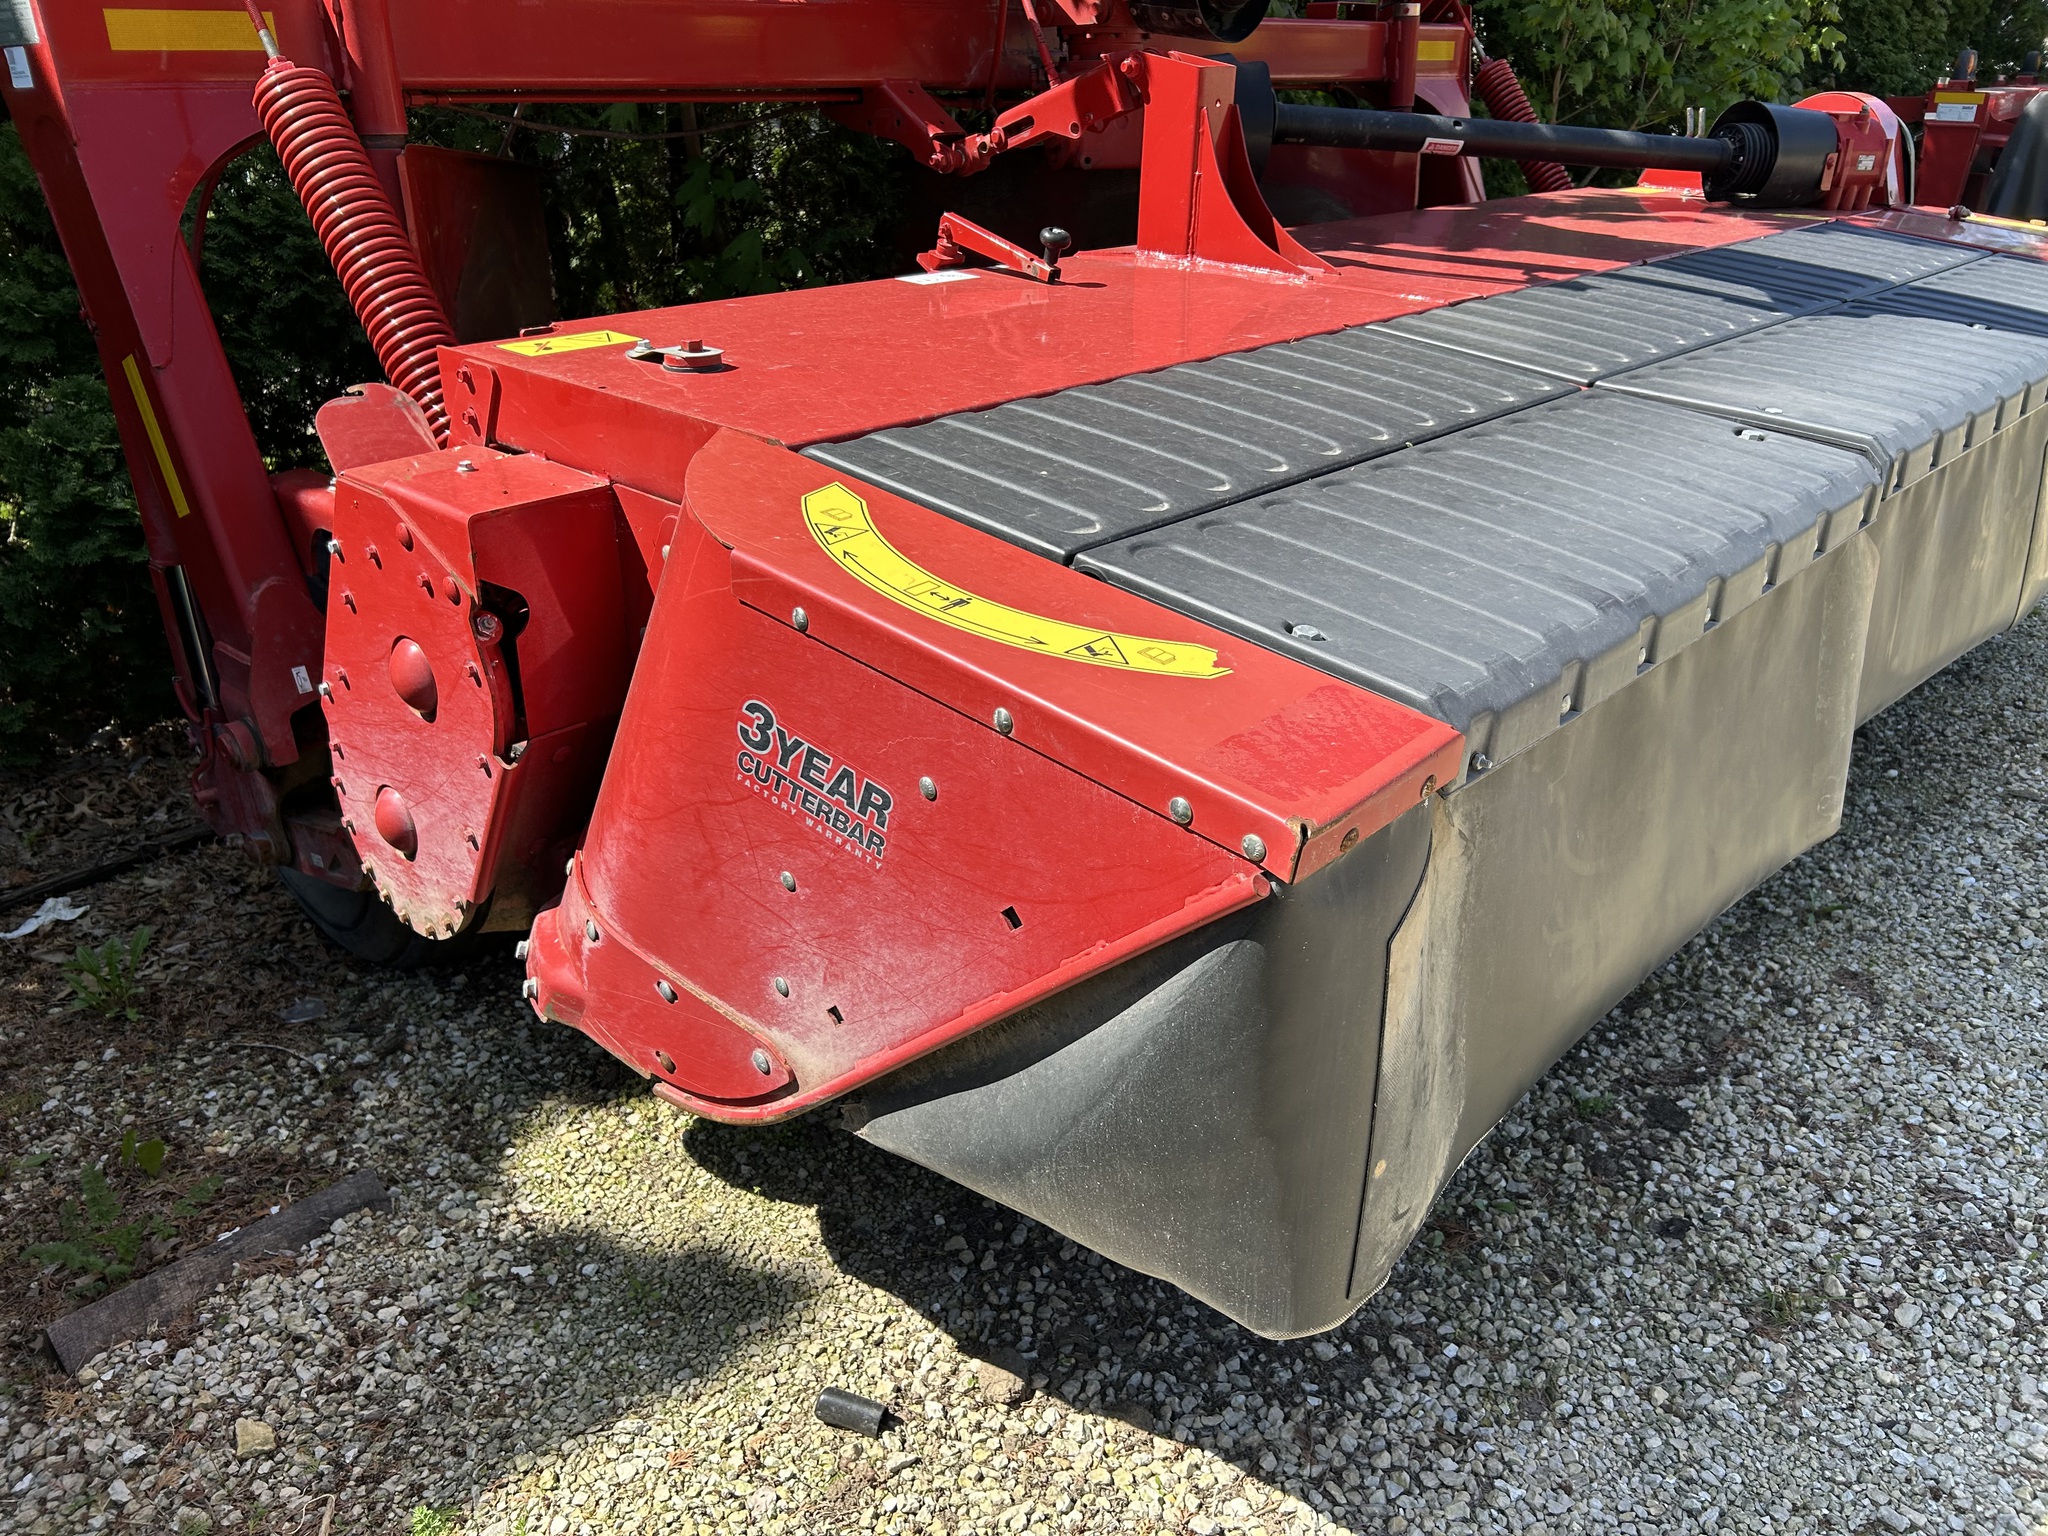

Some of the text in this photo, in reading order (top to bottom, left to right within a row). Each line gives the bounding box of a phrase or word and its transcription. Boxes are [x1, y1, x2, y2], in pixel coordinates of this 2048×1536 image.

[737, 751, 886, 859] CUTTERBAR
[737, 773, 883, 870] FACTORY WARRANTY
